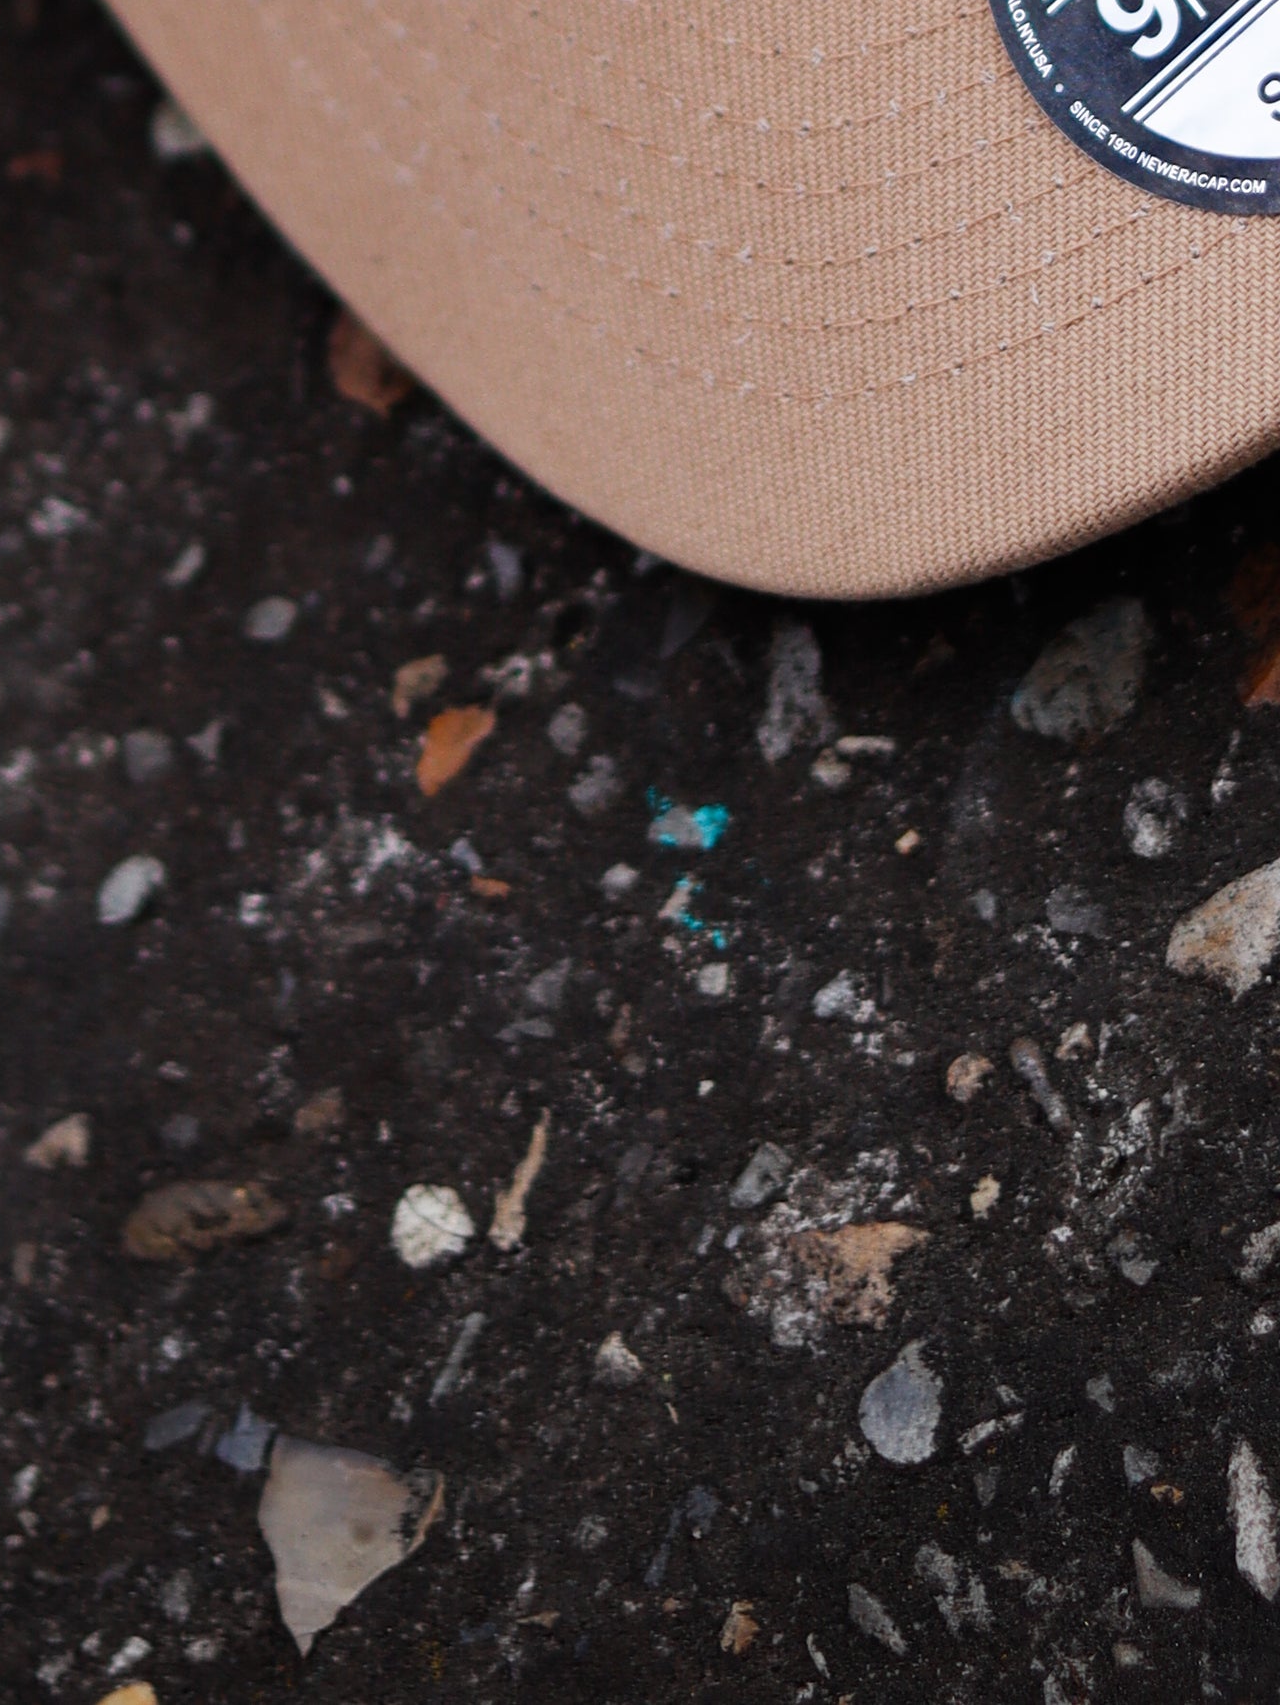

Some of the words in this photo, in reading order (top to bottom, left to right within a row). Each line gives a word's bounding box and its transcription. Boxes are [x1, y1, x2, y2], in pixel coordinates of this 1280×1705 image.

[1069, 100, 1108, 141] SINCE
[1107, 133, 1138, 160] 1920
[1136, 150, 1267, 194] NEWERACAP.COM
